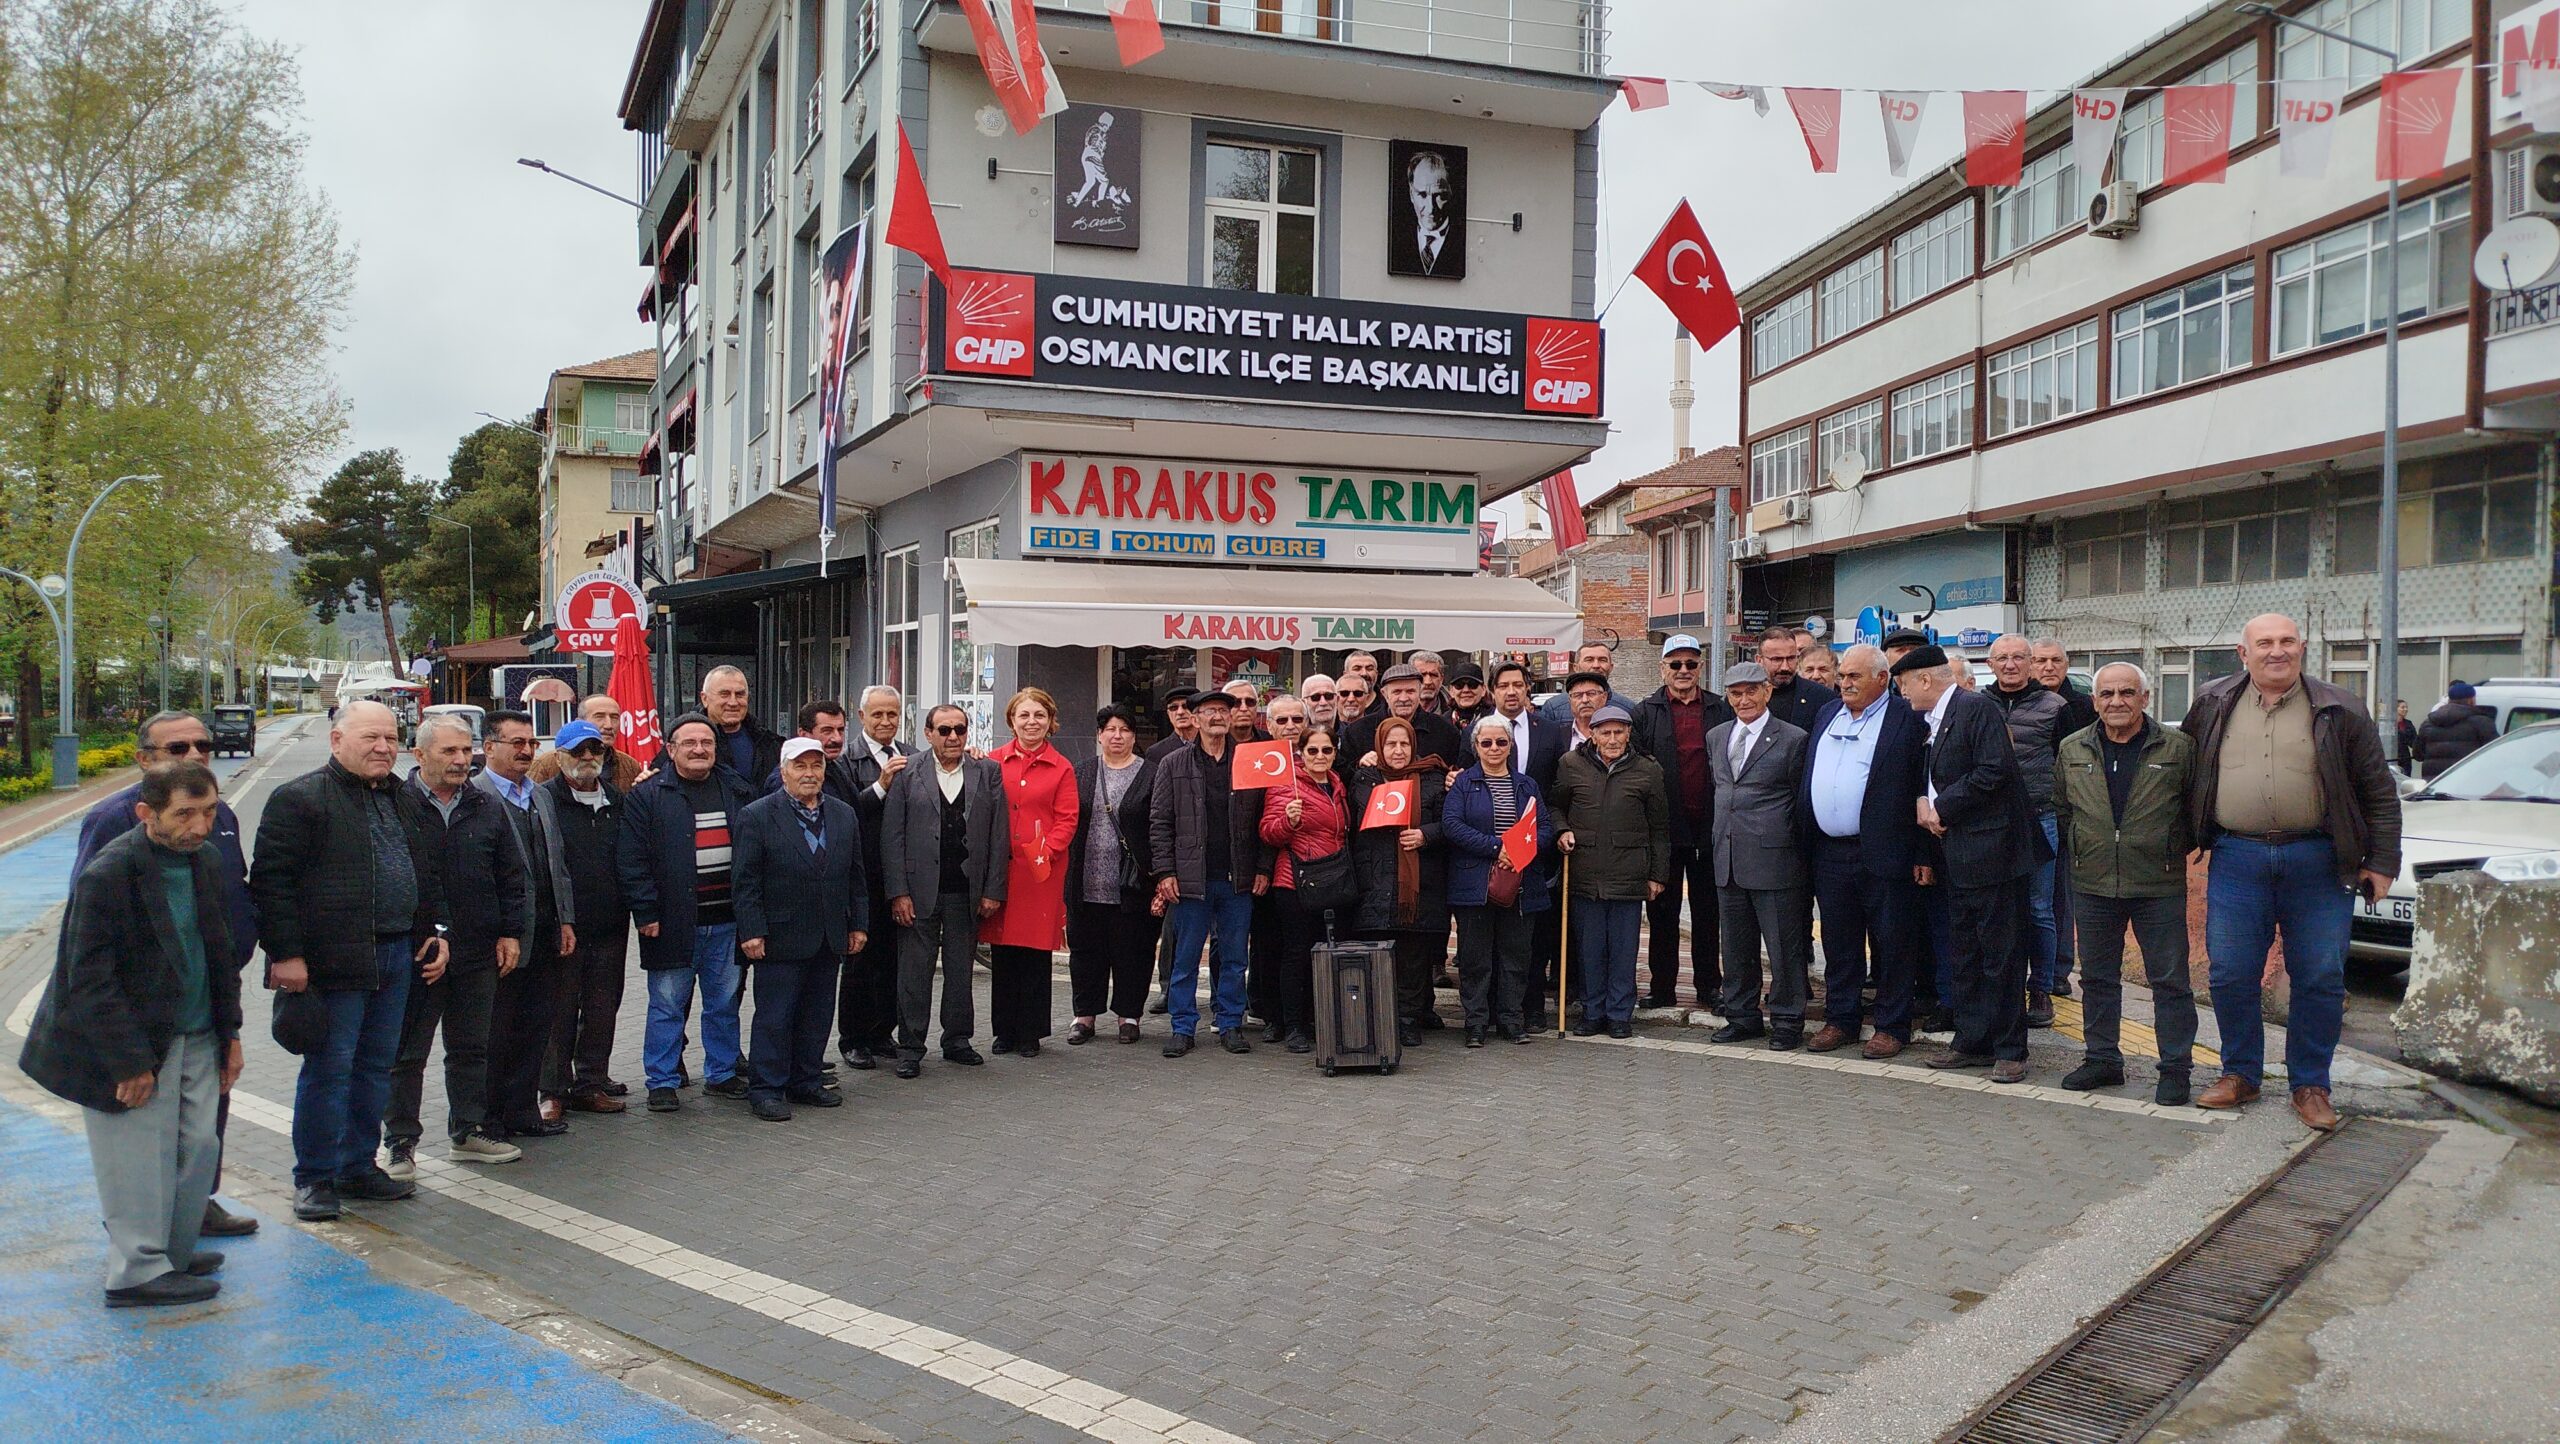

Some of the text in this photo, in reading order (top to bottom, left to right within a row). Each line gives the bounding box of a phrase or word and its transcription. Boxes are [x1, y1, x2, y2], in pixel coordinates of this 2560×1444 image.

[1292, 314, 1382, 346] HALK
[955, 336, 1025, 366] CHP
[1041, 336, 1231, 376] OSMANCIK
[1323, 358, 1519, 395] BAŞKANLIĞI
[1532, 378, 1591, 405] CHP
[1299, 476, 1475, 525] TARIM
[1115, 533, 1213, 554] TOHUM
[1231, 536, 1321, 557] GÜBRE
[602, 572, 622, 584] taze
[1164, 612, 1415, 645] KARAKUŞ TARIM
[1856, 628, 1880, 646] Bora
[1972, 634, 1980, 643] 90
[567, 633, 604, 650] ÇAY
[2393, 902, 2415, 919] 66
